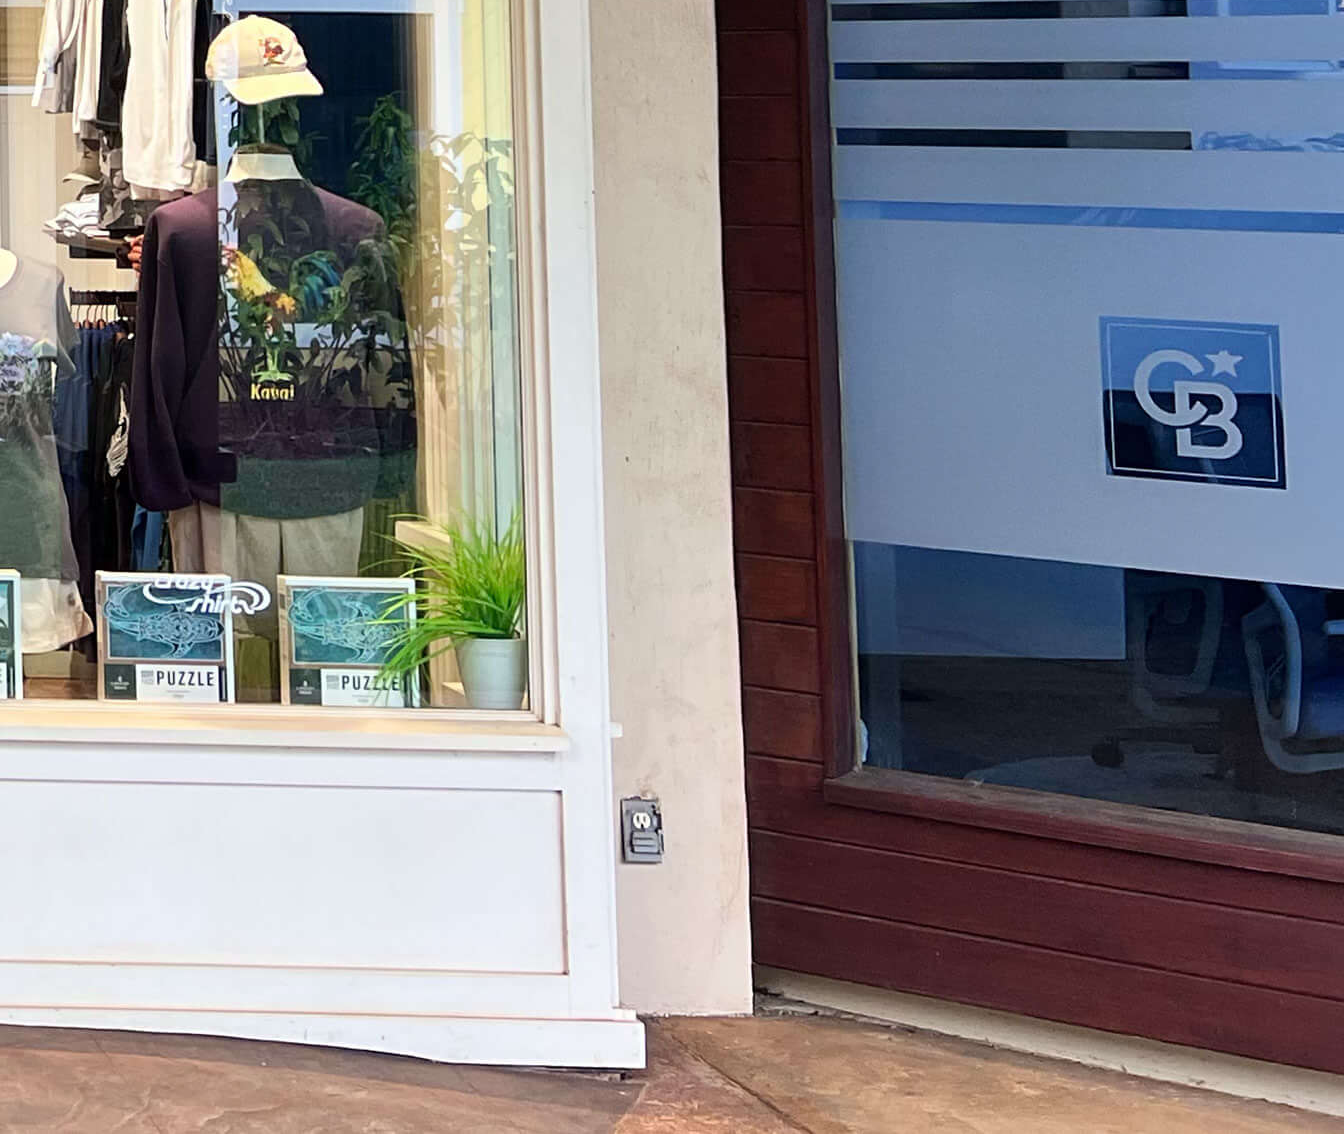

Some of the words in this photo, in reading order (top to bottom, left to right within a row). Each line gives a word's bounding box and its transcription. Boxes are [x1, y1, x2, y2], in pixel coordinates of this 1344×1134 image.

[251, 383, 295, 401] Kauai
[1134, 349, 1243, 460] CB
[155, 578, 215, 596] crazy
[185, 593, 256, 615] shirts
[156, 670, 215, 687] PUZZLE
